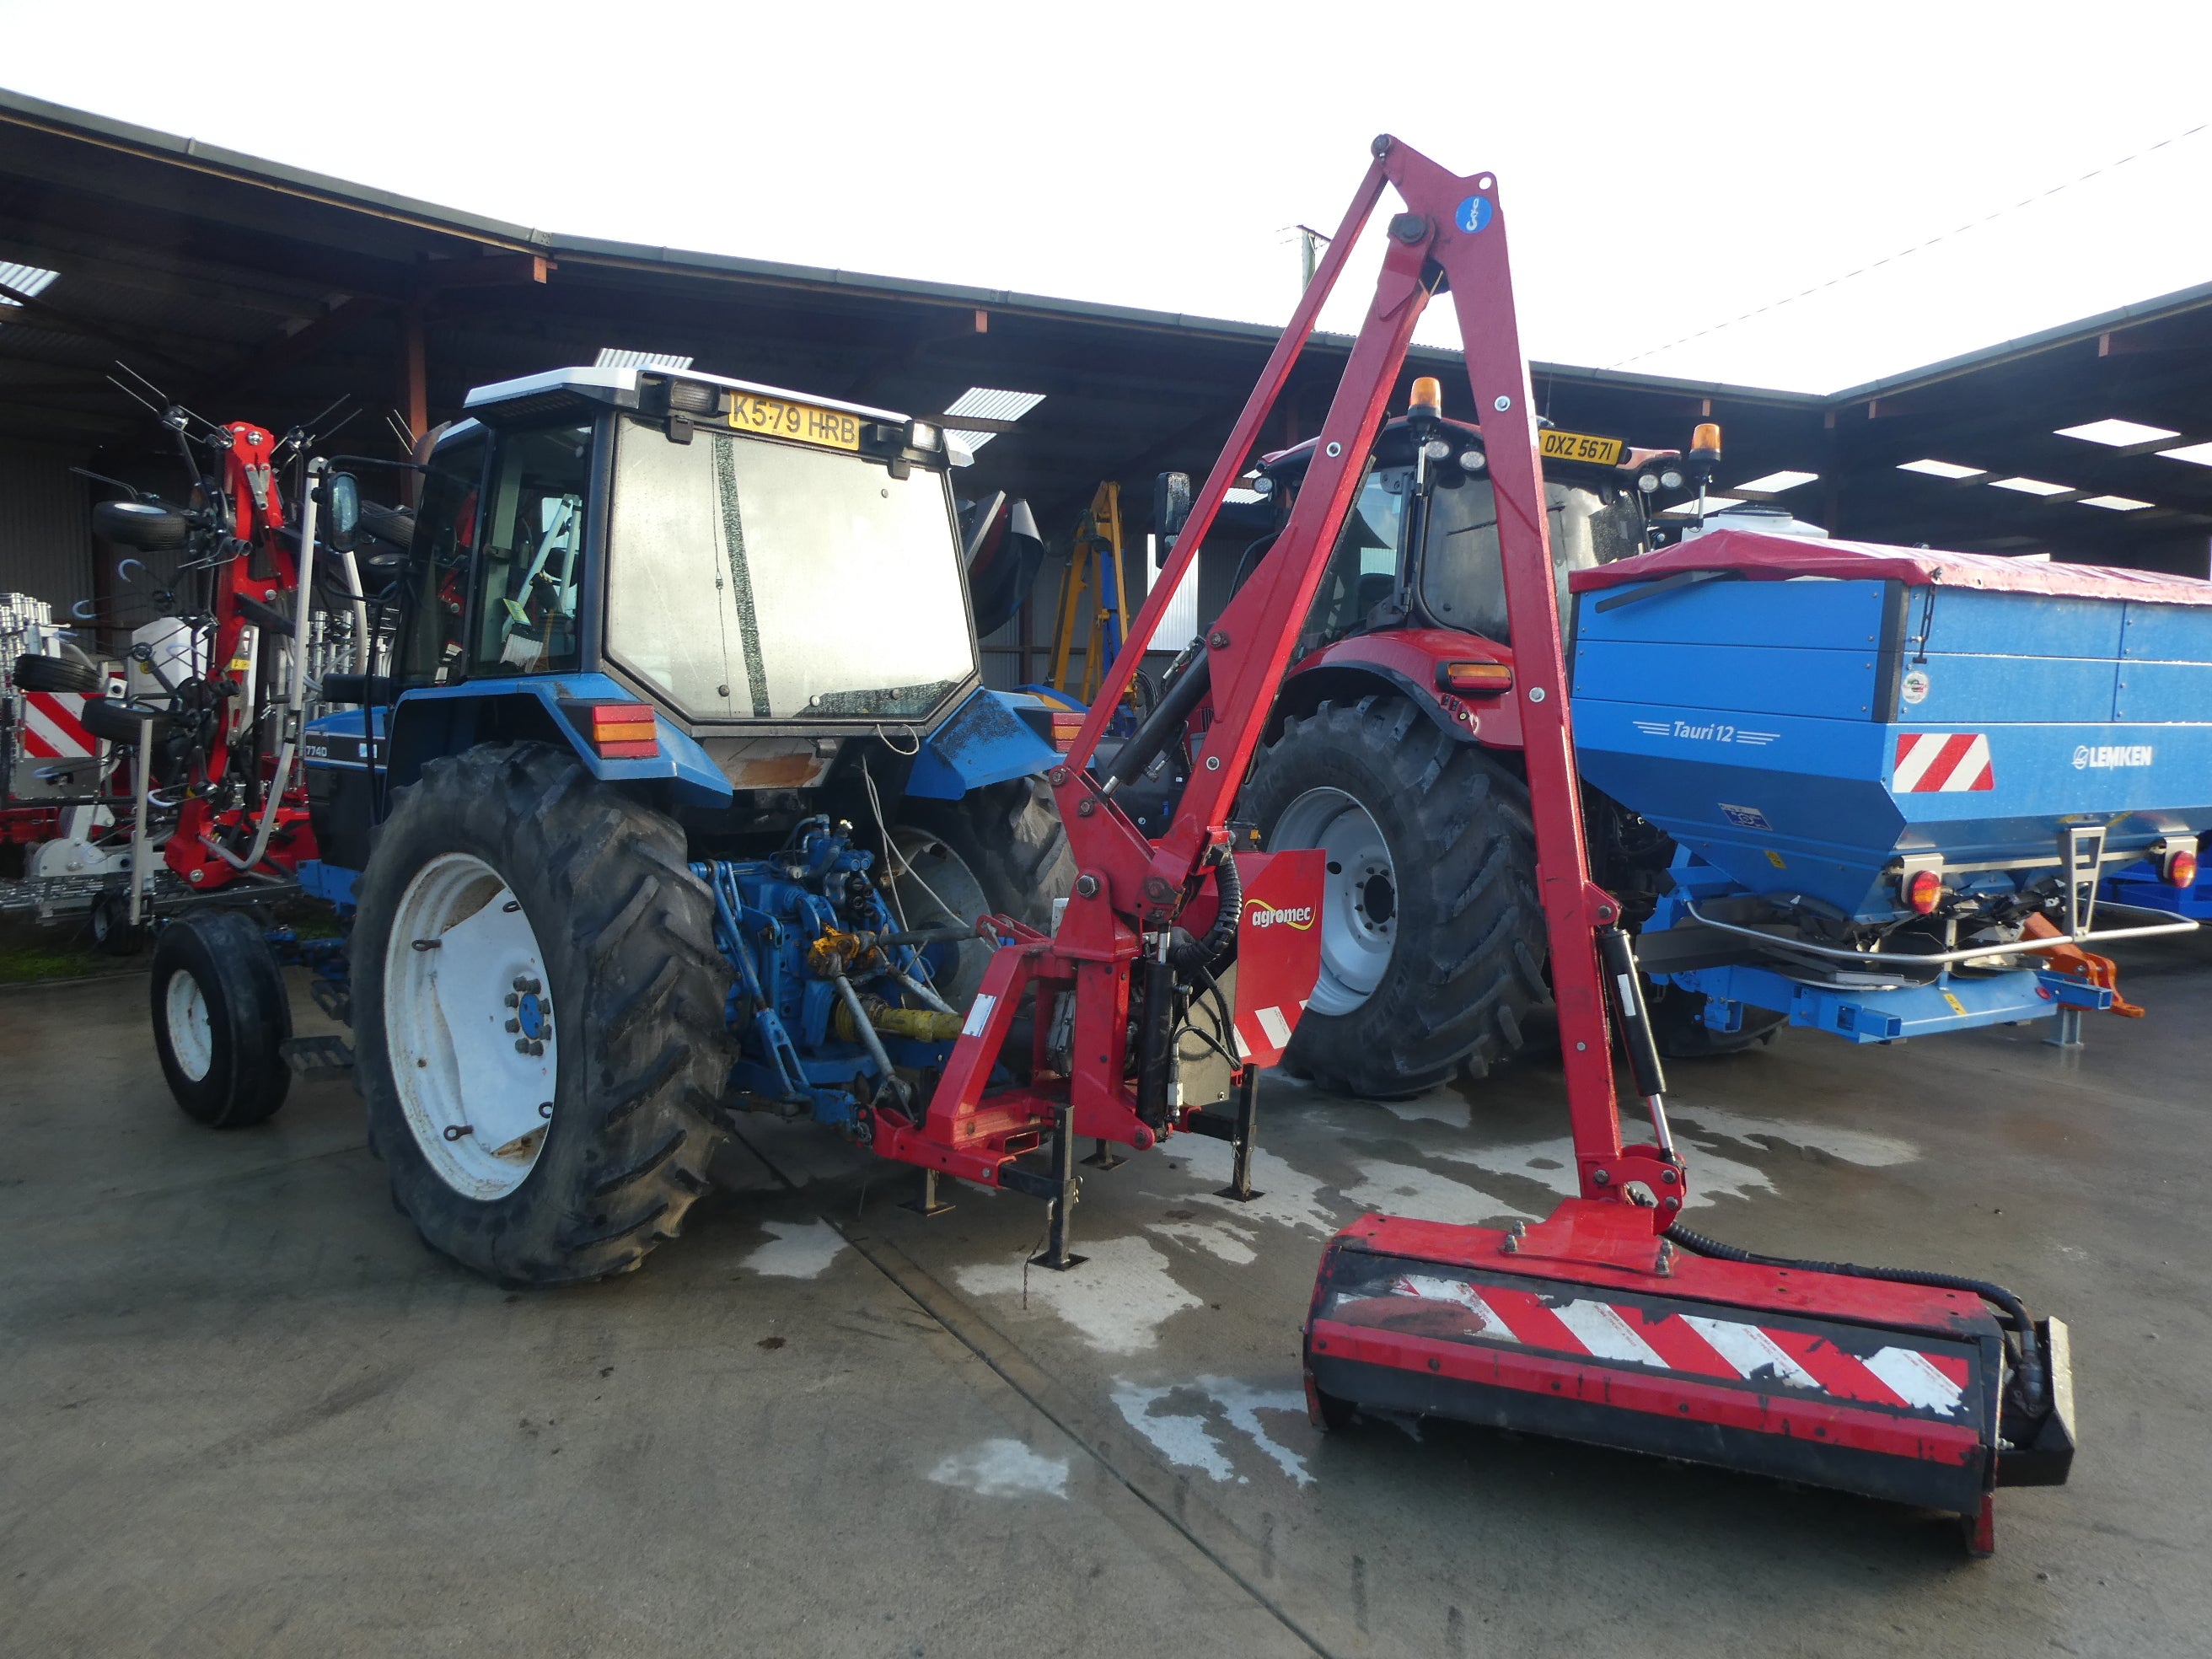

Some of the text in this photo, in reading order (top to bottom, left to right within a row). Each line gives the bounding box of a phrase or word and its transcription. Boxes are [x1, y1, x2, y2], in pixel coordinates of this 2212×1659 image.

[733, 395, 856, 444] K579 HRB
[1544, 435, 1613, 460] OXZ 5671
[1673, 721, 1735, 743] Tauri 12
[306, 745, 328, 758] 7740
[2089, 746, 2153, 769] LEMKEN
[1252, 906, 1311, 928] agromec
